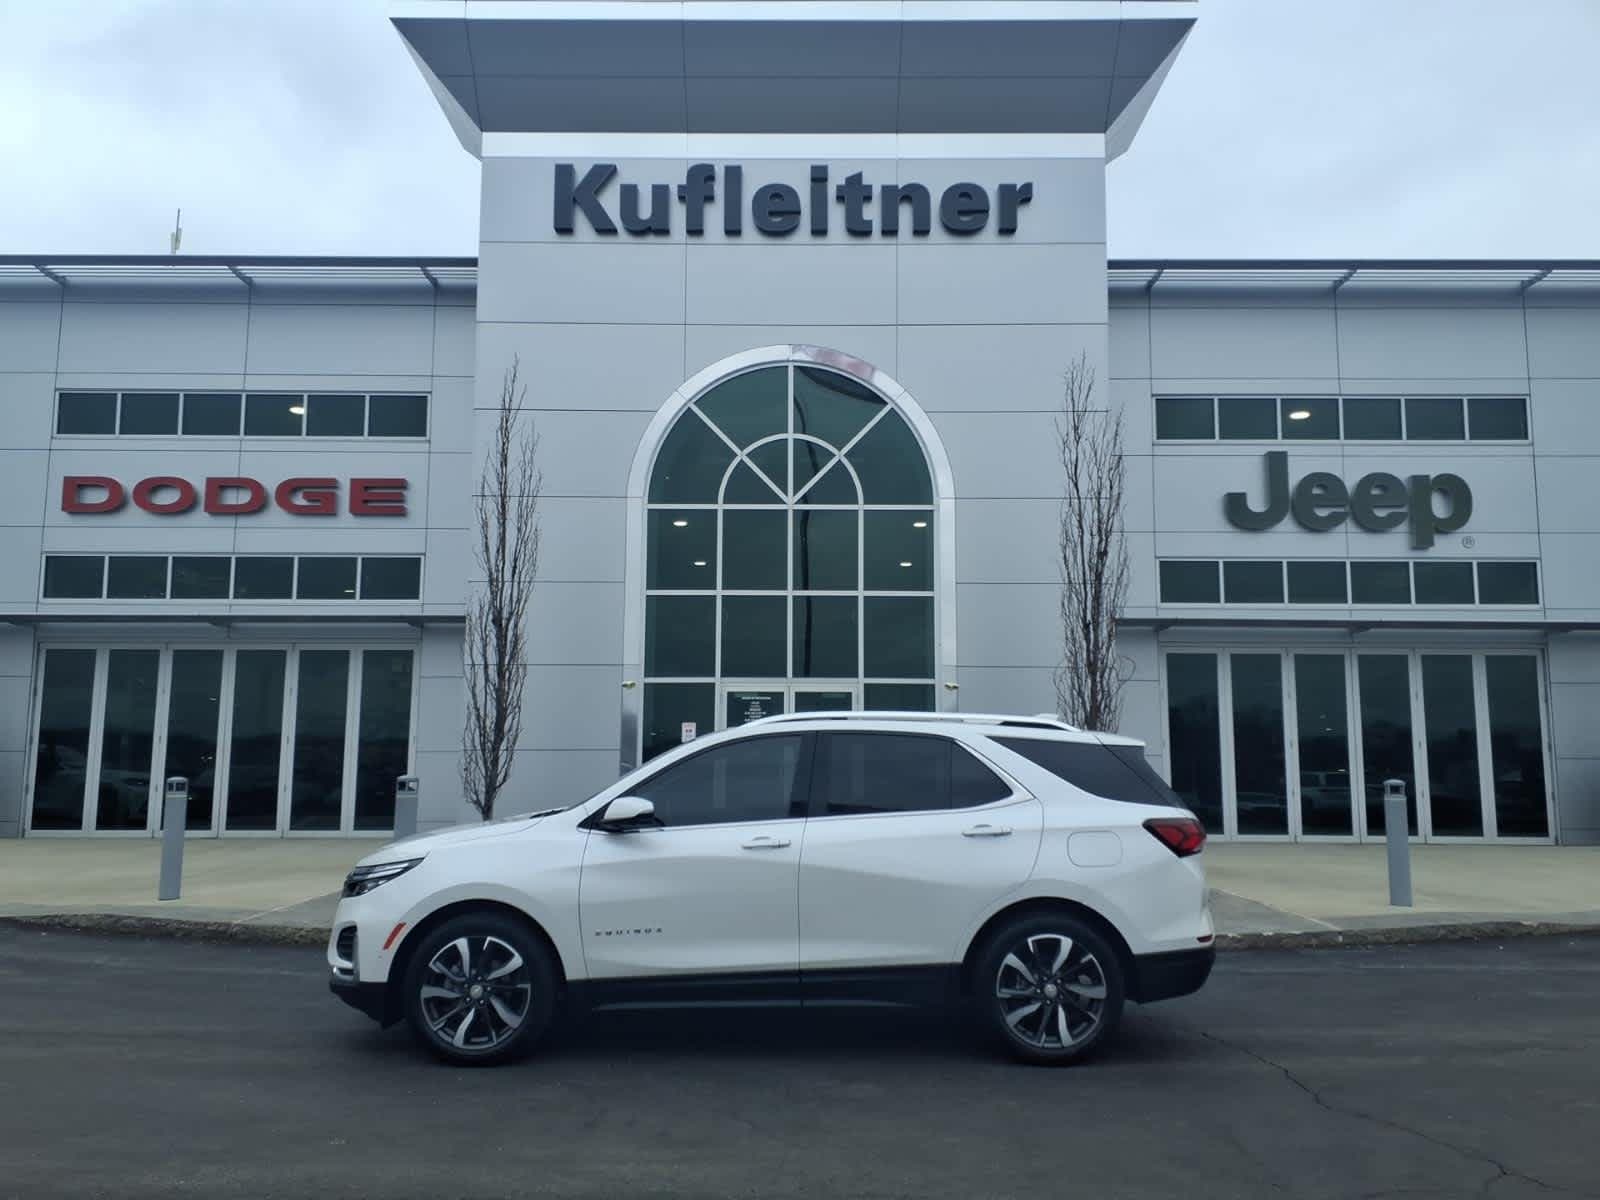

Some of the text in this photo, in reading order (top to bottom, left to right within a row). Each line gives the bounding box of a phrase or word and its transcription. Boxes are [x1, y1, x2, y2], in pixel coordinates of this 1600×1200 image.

[553, 163, 1033, 236] Kufleitner
[61, 476, 408, 517] DODGE
[1224, 451, 1473, 550] Jeep
